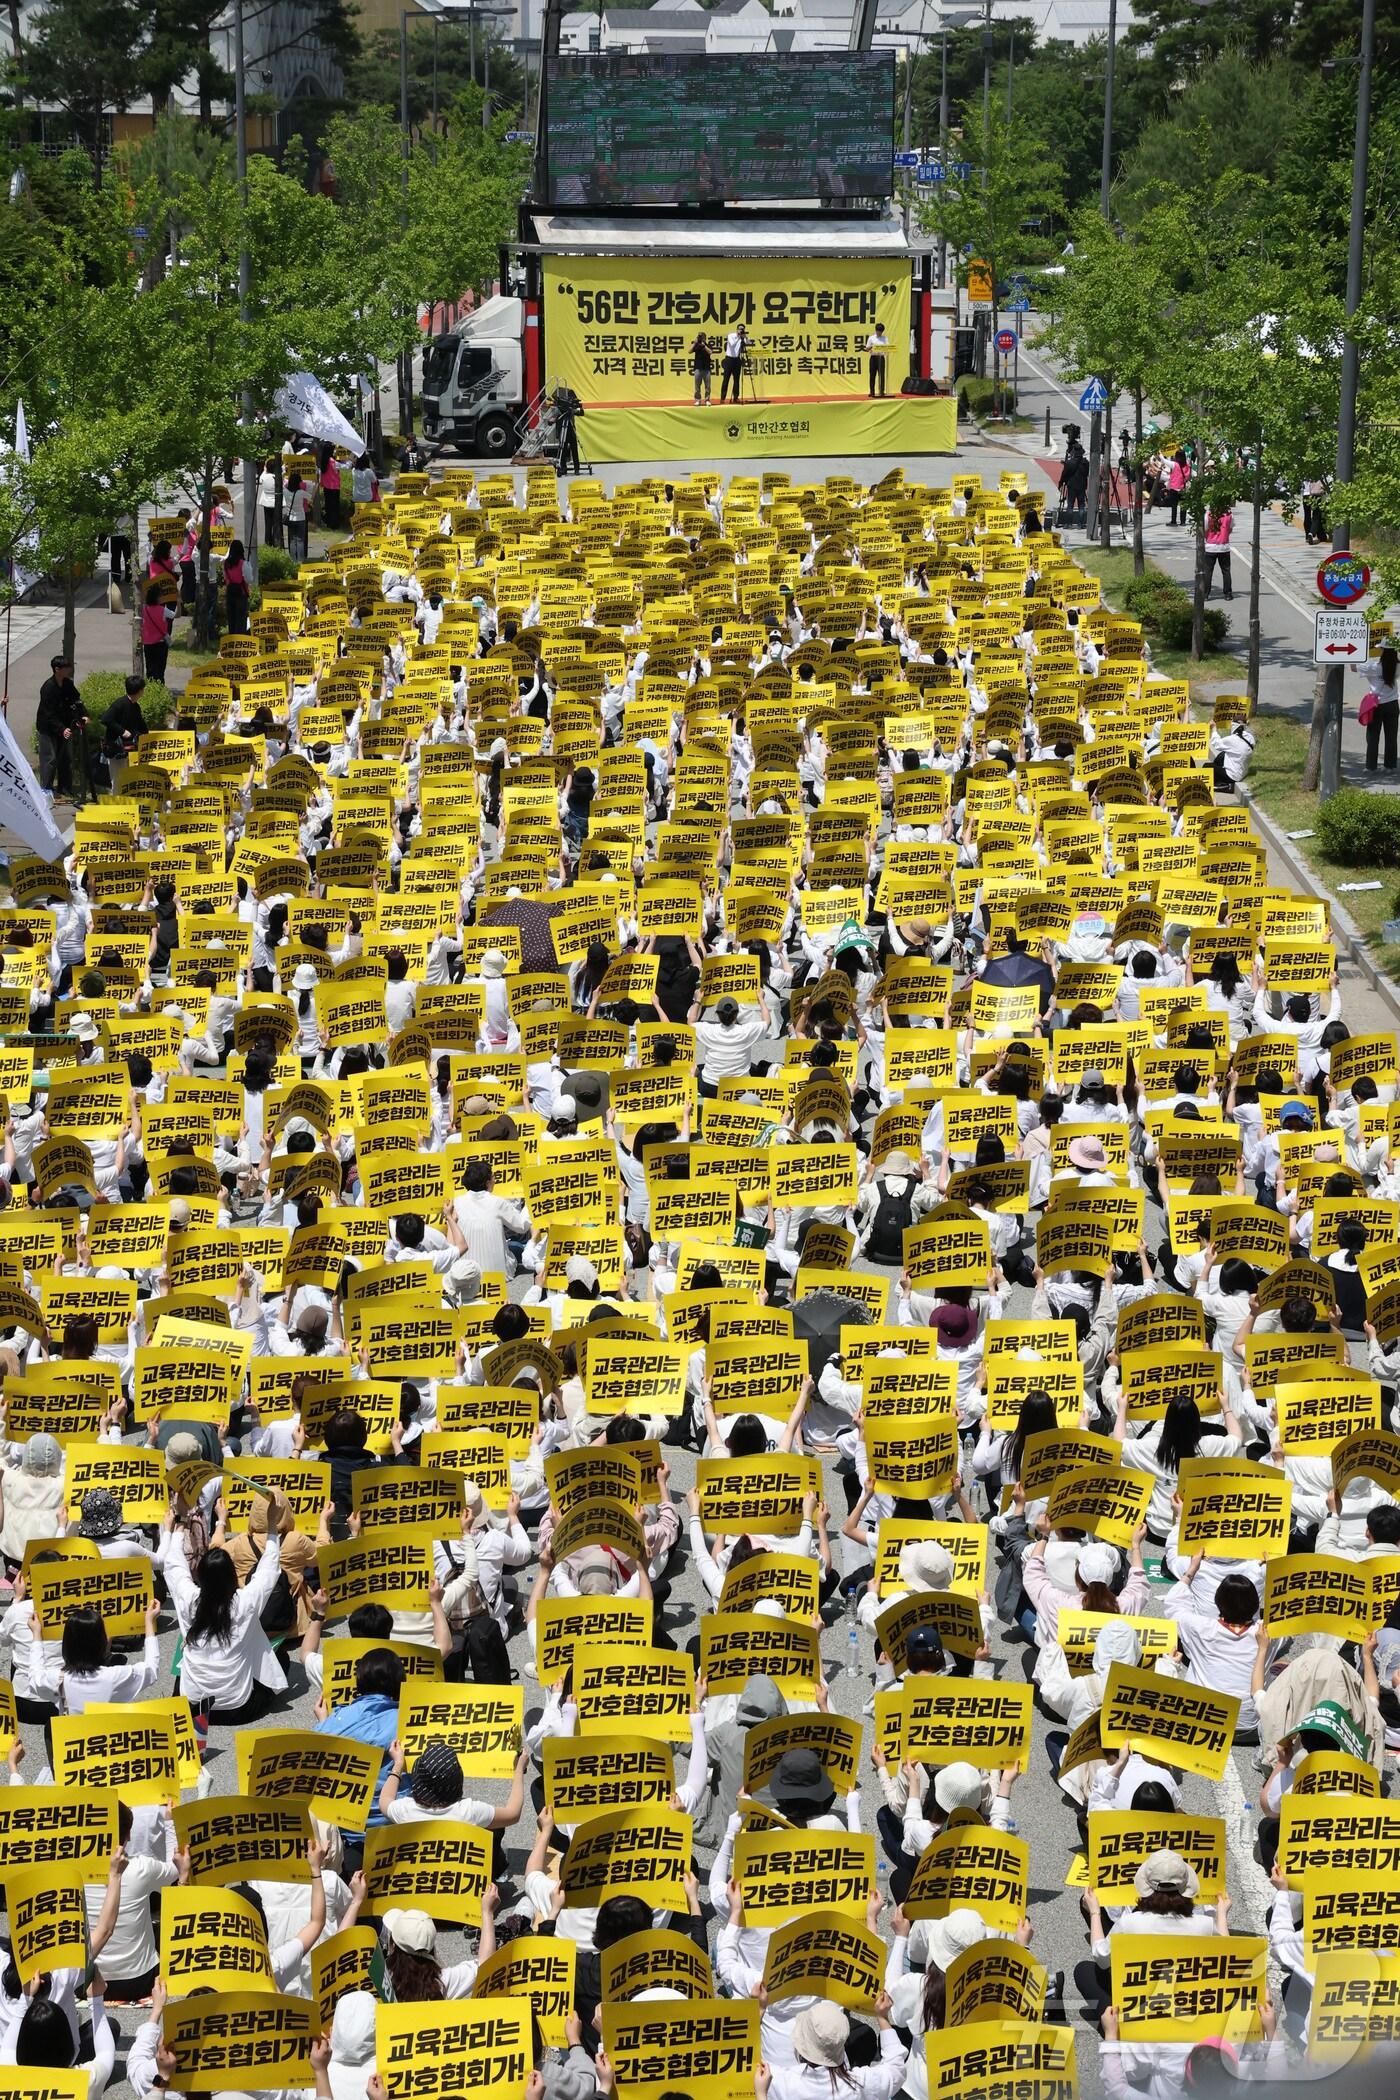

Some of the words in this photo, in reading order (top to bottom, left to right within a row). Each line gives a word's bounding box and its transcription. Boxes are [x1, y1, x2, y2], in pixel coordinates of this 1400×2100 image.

[647, 292, 756, 325] 간호사가
[583, 336, 684, 354] 진료지원업무
[817, 336, 848, 352] 교육
[592, 358, 627, 376] 자격
[632, 358, 664, 376] 관리
[797, 356, 862, 375] 촉구대회
[747, 421, 810, 434] 대한간호협회
[897, 804, 942, 817] 간호협회가!
[898, 792, 940, 805] 교육관리는
[812, 819, 863, 831] 교육관리는
[811, 830, 864, 845] 간호협회가!
[889, 850, 940, 864] 교육관리는
[1143, 845, 1194, 859] 교육관리는
[1144, 857, 1196, 871] 간호협회가!
[94, 868, 145, 882] 교육관리는
[405, 870, 455, 881] 교육관리는
[1200, 862, 1251, 876] 교육관리는
[180, 882, 233, 897] 교육관리는
[1162, 890, 1217, 902] 교육관리는
[805, 899, 858, 913] 교육관리는
[1162, 904, 1217, 916] 간호협회가!
[642, 912, 698, 926] 간호협회가!
[176, 957, 234, 972] 교육관리는
[1268, 952, 1329, 966] 교육관리는
[1060, 973, 1117, 984] 교육관리는
[1267, 968, 1330, 982] 간호협회가!
[704, 978, 758, 997] 간호협회가!
[892, 991, 947, 1004] 간호협회가!
[975, 995, 1035, 1009] 교육관리는
[328, 1015, 386, 1038] 간호협회가!
[974, 1008, 1035, 1021] 간호협회가!
[561, 1043, 627, 1060] 간호협회가!
[1058, 1041, 1122, 1056] 교육관리는
[1334, 1042, 1392, 1068] 교육관리는
[1332, 1057, 1394, 1084] 간호협회가!
[615, 1076, 682, 1096] 교육관리는
[51, 1094, 122, 1109] 교육관리는
[616, 1092, 685, 1112] 간호협회가!
[48, 1112, 122, 1127] 간호협회가!
[148, 1111, 212, 1132] 교육관리는
[948, 1106, 1012, 1124] 교육관리는
[369, 1164, 440, 1189] 교육관리는
[696, 1158, 768, 1176] 교육관리는
[776, 1154, 850, 1176] 교육관리는
[370, 1182, 444, 1208] 간호협회가!
[529, 1172, 598, 1198] 교육관리는
[656, 1192, 730, 1210] 교육관리는
[92, 1216, 164, 1234] 교육관리는
[656, 1210, 732, 1230] 간호협회가!
[1040, 1221, 1108, 1244] 교육관리는
[171, 1239, 240, 1262] 교육관리는
[550, 1238, 618, 1256] 교육관리는
[908, 1232, 983, 1259] 교육관리는
[1214, 1236, 1286, 1254] 간호협회가!
[171, 1263, 242, 1288] 간호협회가!
[908, 1252, 986, 1279] 간호협회가!
[369, 1320, 452, 1342] 교육관리는
[369, 1341, 456, 1365] 간호협회가!
[713, 1352, 800, 1378] 교육관리는
[141, 1363, 226, 1384] 교육관리는
[994, 1374, 1076, 1394] 교육관리는
[1129, 1362, 1214, 1388] 교육관리는
[592, 1378, 682, 1399] 간호협회가!
[711, 1377, 801, 1399] 간호협회가!
[7, 1394, 100, 1412] 교육관리는
[444, 1400, 532, 1421] 교육관리는
[1286, 1395, 1372, 1420] 교육관리는
[9, 1416, 99, 1434] 간호협회가!
[873, 1433, 952, 1458] 교육관리는
[72, 1460, 160, 1482] 교육관리는
[555, 1461, 636, 1491] 교육관리는
[360, 1480, 456, 1504] 교육관리는
[558, 1480, 638, 1516] 간호협회가!
[1054, 1478, 1144, 1504] 교육관리는
[358, 1502, 461, 1527] 간호협회가!
[704, 1498, 804, 1520] 간호협회가!
[328, 1546, 425, 1581] 교육관리는
[42, 1571, 143, 1602] 교육관리는
[330, 1570, 429, 1604] 간호협회가!
[1271, 1571, 1365, 1597] 교육관리는
[1269, 1592, 1367, 1623] 간호협회가!
[544, 1613, 644, 1642] 교육관리는
[708, 1633, 810, 1654] 교육관리는
[581, 1665, 686, 1690] 교육관리는
[707, 1656, 813, 1679] 간호협회가!
[406, 1702, 514, 1727] 교육관리는
[910, 1698, 1022, 1718] 교육관리는
[1112, 1685, 1228, 1725] 교육관리는
[750, 1727, 853, 1756] 교육관리는
[907, 1725, 1024, 1753] 간호협회가!
[1108, 1710, 1226, 1750] 간호협회가!
[64, 1729, 168, 1764] 교육관리는
[65, 1756, 175, 1787] 간호협회가!
[257, 1752, 370, 1778] 교육관리는
[553, 1752, 666, 1780] 교육관리는
[256, 1775, 368, 1803] 간호협회가!
[554, 1780, 671, 1808] 간호협회가!
[188, 1812, 302, 1850] 교육관리는
[372, 1840, 485, 1871] 교육관리는
[571, 1827, 683, 1863] 교육관리는
[1098, 1830, 1215, 1858] 교육관리는
[190, 1838, 308, 1878] 간호협회가!
[744, 1848, 864, 1878] 교육관리는
[916, 1846, 1020, 1878] 교육관리는
[569, 1856, 685, 1890] 간호협회가!
[365, 1880, 487, 1910] 간호협회가!
[743, 1877, 868, 1906] 간호협회가!
[918, 1876, 1022, 1904] 간호협회가!
[771, 1930, 878, 1970] 교육관리는
[767, 1956, 881, 1995] 간호협회가!
[1122, 1956, 1252, 1987] 교육관리는
[1122, 1986, 1258, 2022] 간호협회가!
[174, 2010, 309, 2042] 교육관리는
[615, 2018, 749, 2048] 교육관리는
[388, 2019, 520, 2062] 교육관리는
[175, 2036, 316, 2075] 간호협회가!
[616, 2047, 753, 2084] 간호협회가!
[938, 2044, 1064, 2088] 교육관리는
[388, 2055, 525, 2100] 간호협회가!
